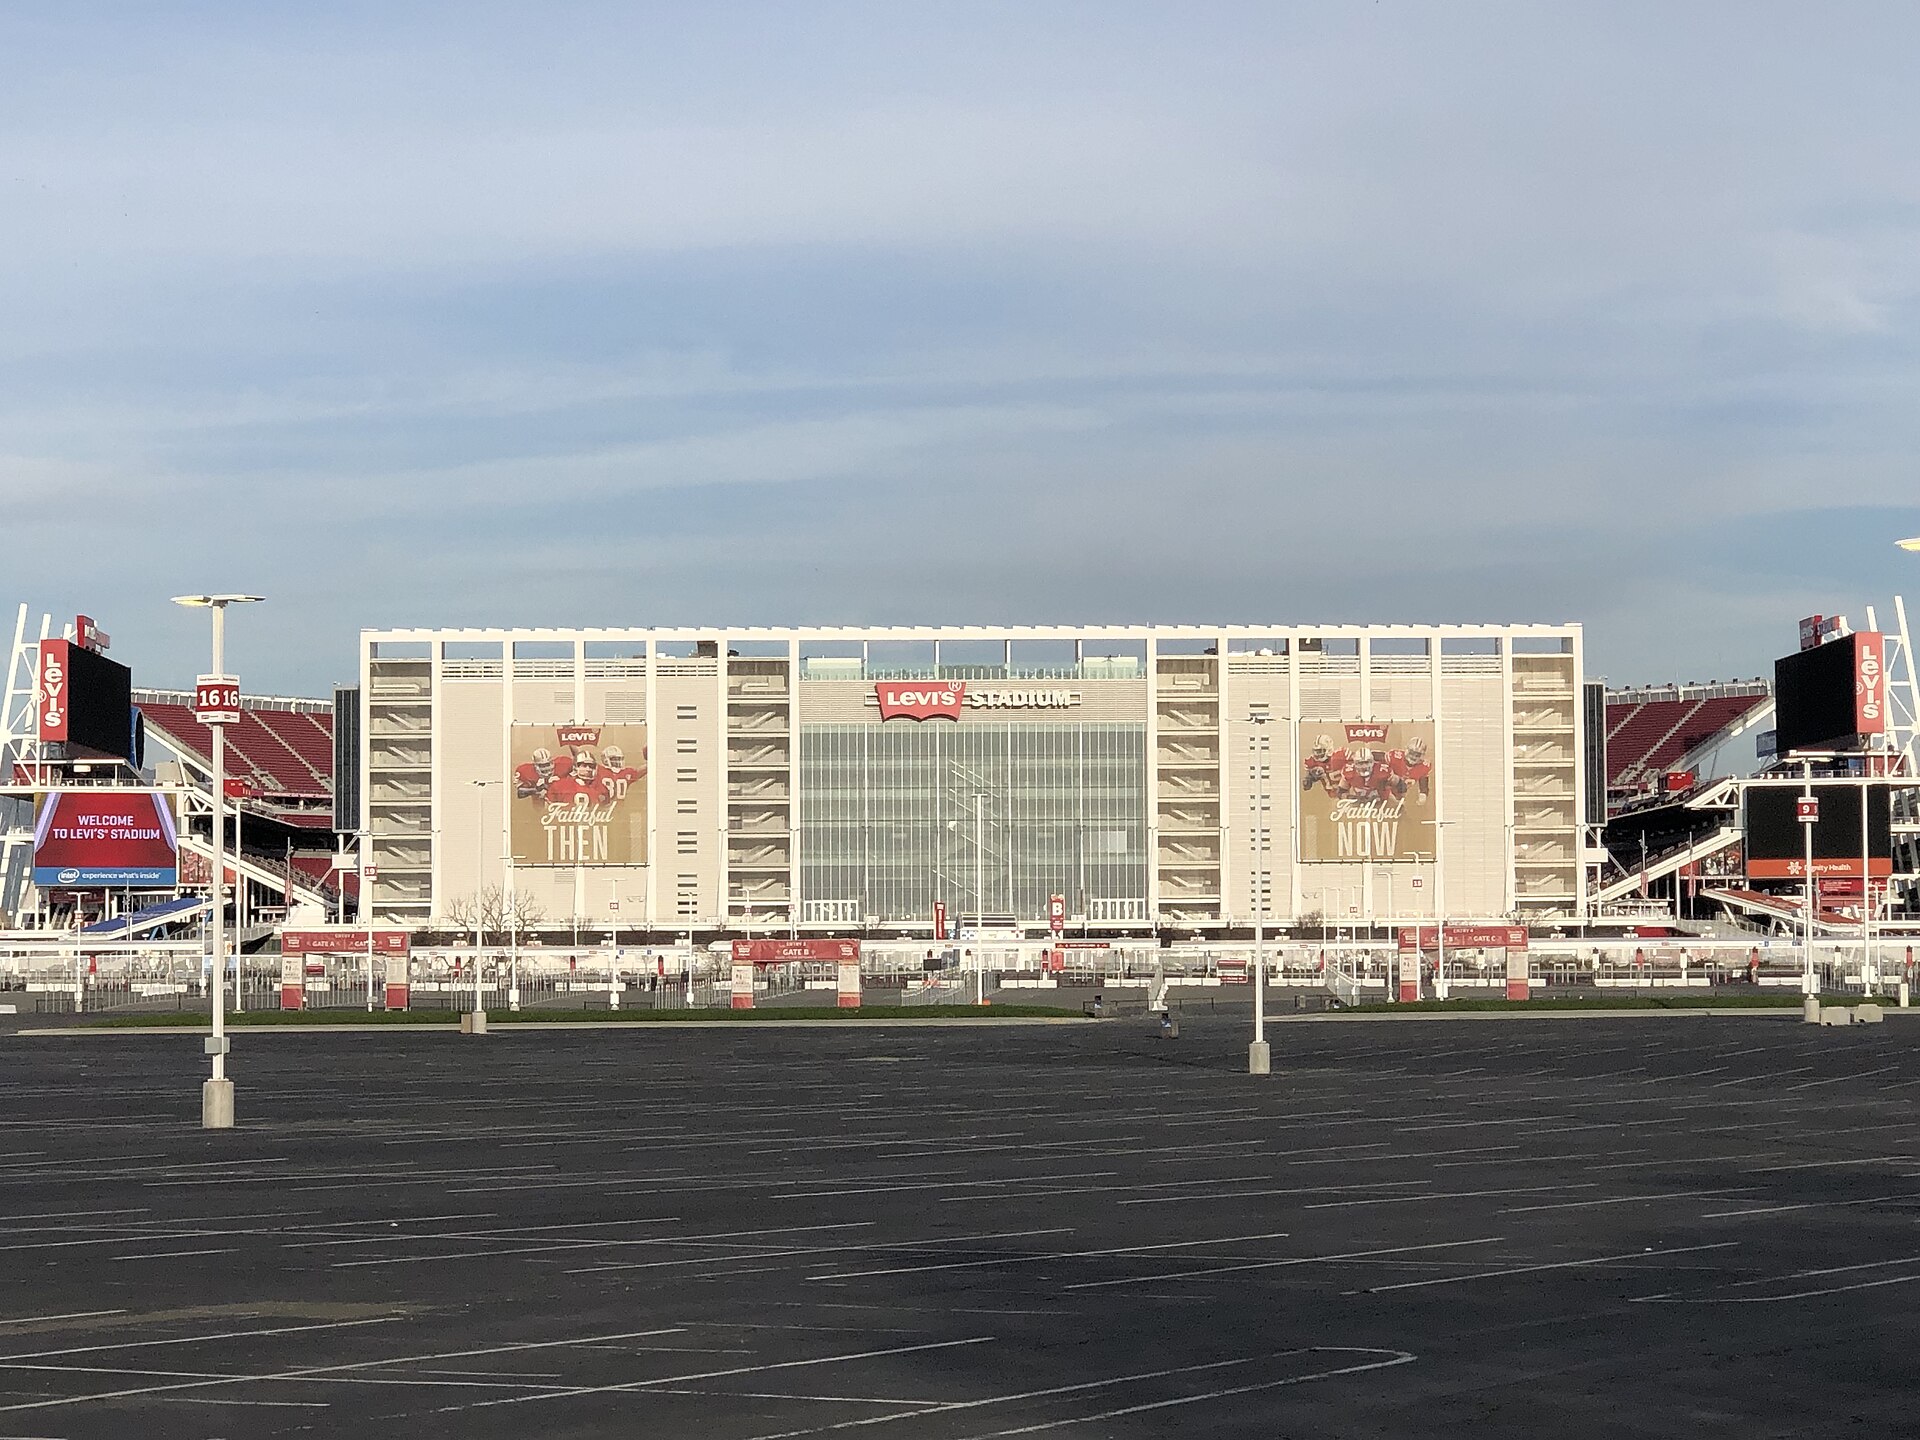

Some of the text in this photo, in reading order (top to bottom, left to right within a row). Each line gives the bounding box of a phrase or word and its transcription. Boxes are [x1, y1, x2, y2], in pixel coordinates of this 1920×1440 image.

[200, 690, 220, 706] 16
[223, 690, 238, 706] 16
[971, 689, 1073, 708] STADIUM
[541, 801, 617, 825] Faithful
[1330, 798, 1405, 822] Faithful
[1803, 805, 1809, 813] 9
[78, 815, 134, 826] WELCOME
[53, 828, 67, 839] TO
[111, 828, 160, 839] STADIUM
[1338, 822, 1398, 857] NOW
[544, 826, 608, 861] THEN
[1052, 902, 1063, 915] B
